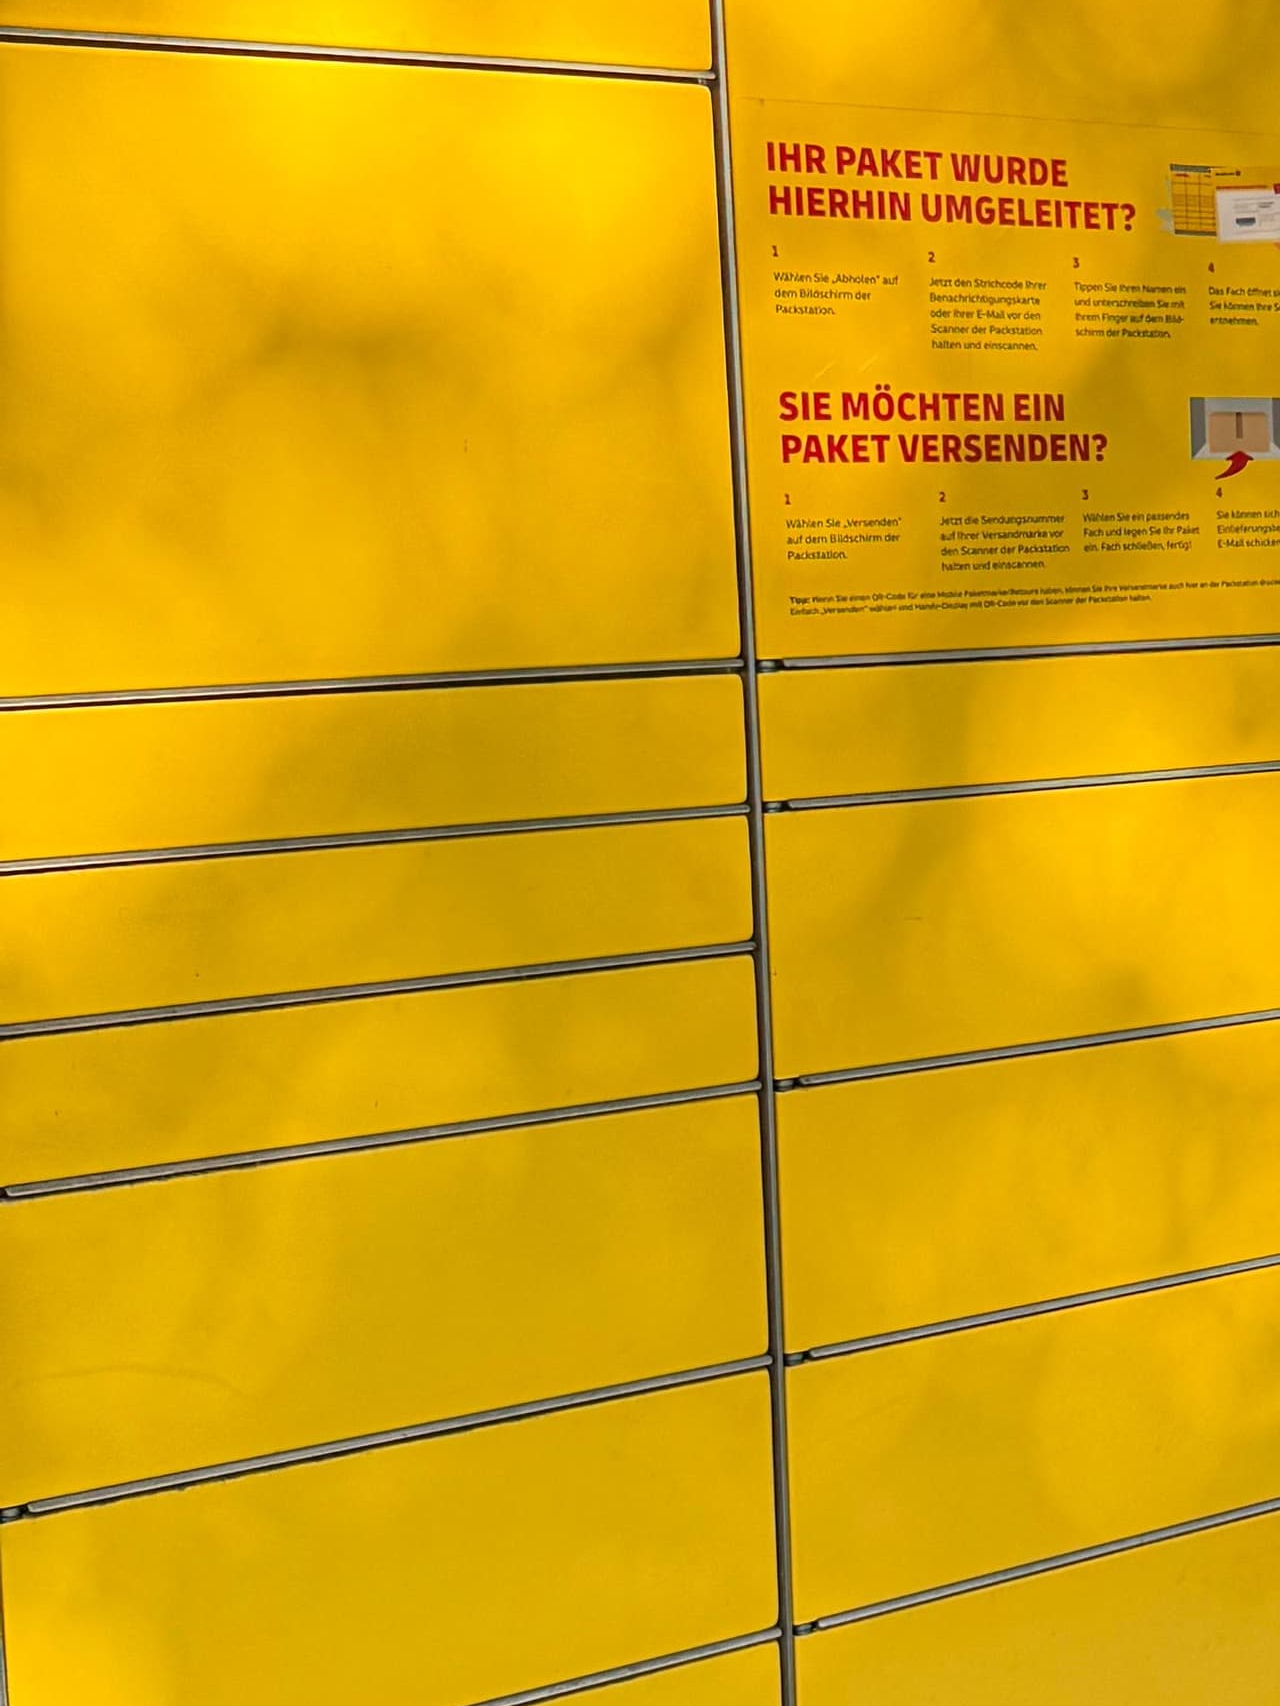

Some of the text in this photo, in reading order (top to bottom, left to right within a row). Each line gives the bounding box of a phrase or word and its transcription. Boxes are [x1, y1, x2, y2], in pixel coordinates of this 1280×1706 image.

[766, 141, 1069, 187] IHR PAKET WURDE
[768, 185, 1136, 232] HIERHIN UMGELEITET?
[928, 251, 935, 263] 2
[1073, 257, 1080, 269] 3
[779, 383, 1065, 422] SIE MÖCHTEN EIN
[781, 432, 1108, 464] PAKET VERSENDEN?
[939, 491, 946, 503] 2
